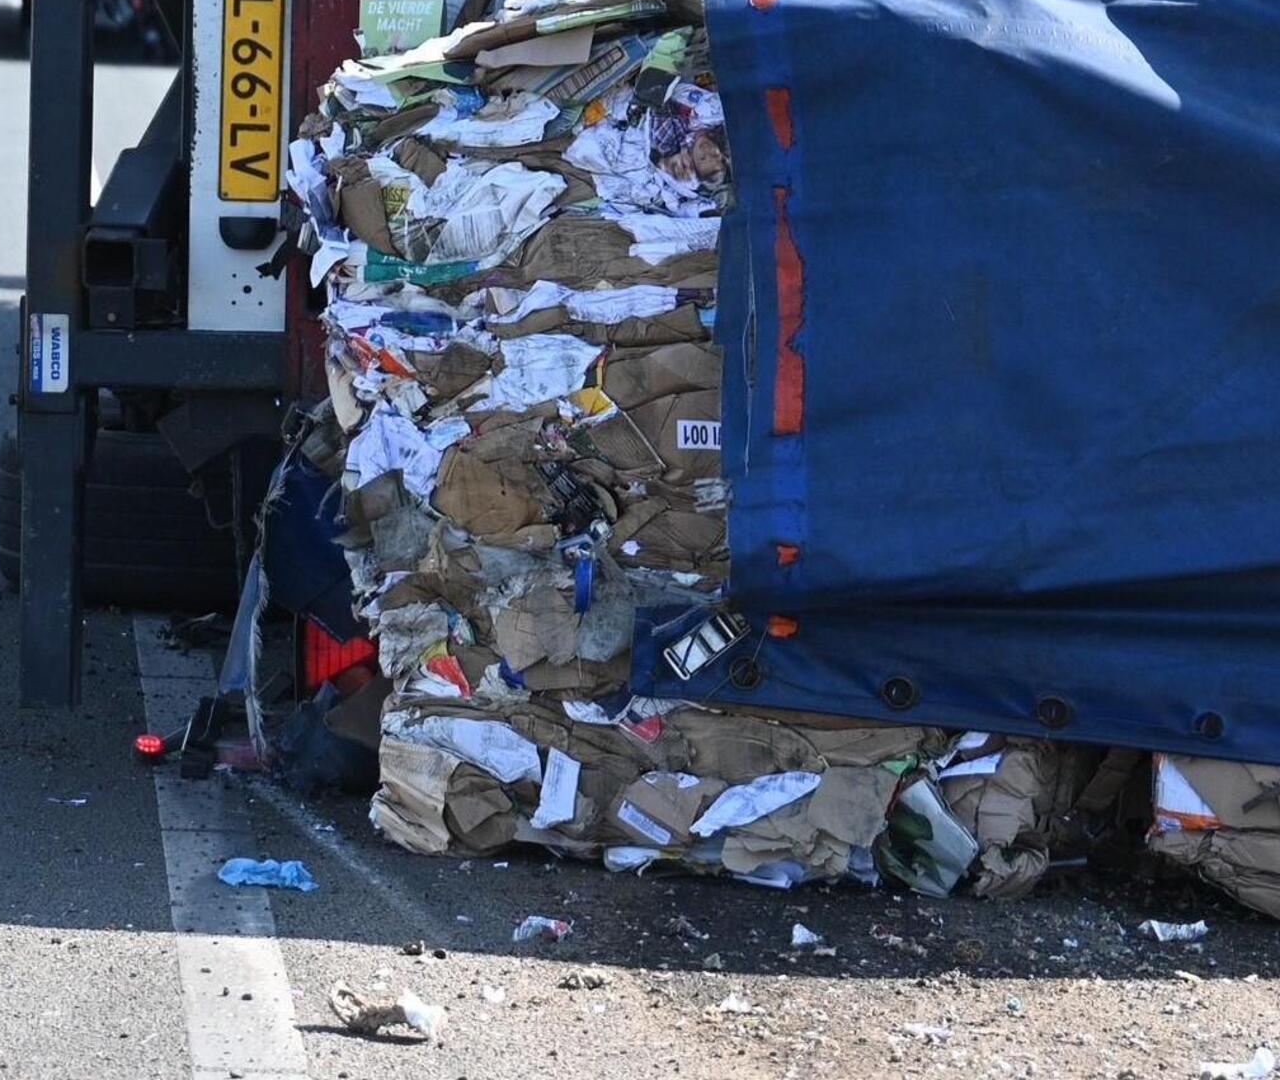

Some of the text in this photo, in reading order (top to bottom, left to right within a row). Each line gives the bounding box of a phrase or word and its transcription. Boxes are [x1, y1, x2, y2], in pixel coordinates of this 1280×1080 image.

[368, 1, 385, 15] DE
[376, 18, 423, 32] MACHT
[51, 327, 60, 380] WABCO
